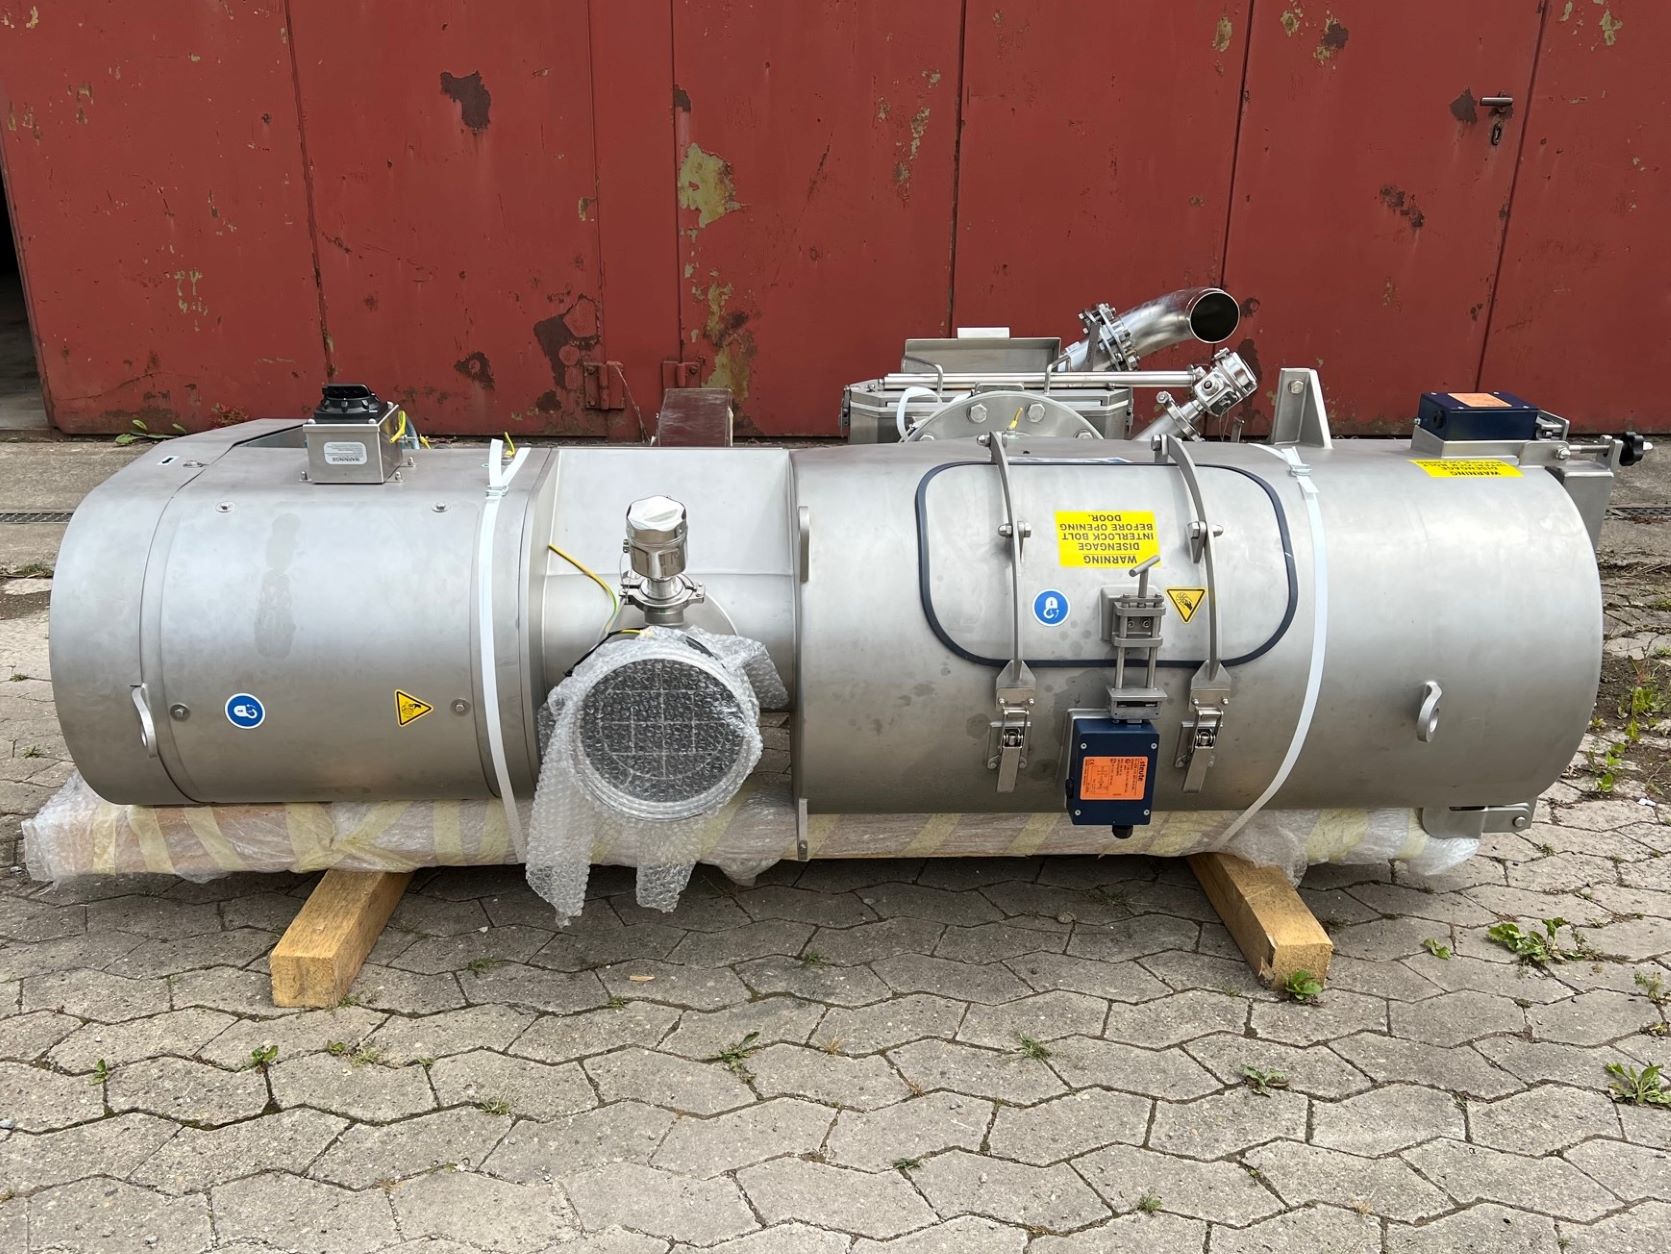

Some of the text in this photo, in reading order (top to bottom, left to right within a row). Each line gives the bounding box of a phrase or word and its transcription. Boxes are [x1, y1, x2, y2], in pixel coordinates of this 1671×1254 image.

[1088, 514, 1122, 522] DOOR.
[1059, 523, 1153, 531] BEFORE OPENING
[1061, 532, 1154, 541] INTERLOCK BOLT
[1078, 542, 1140, 551] DISENGAGE
[1083, 555, 1137, 564] WARNING
